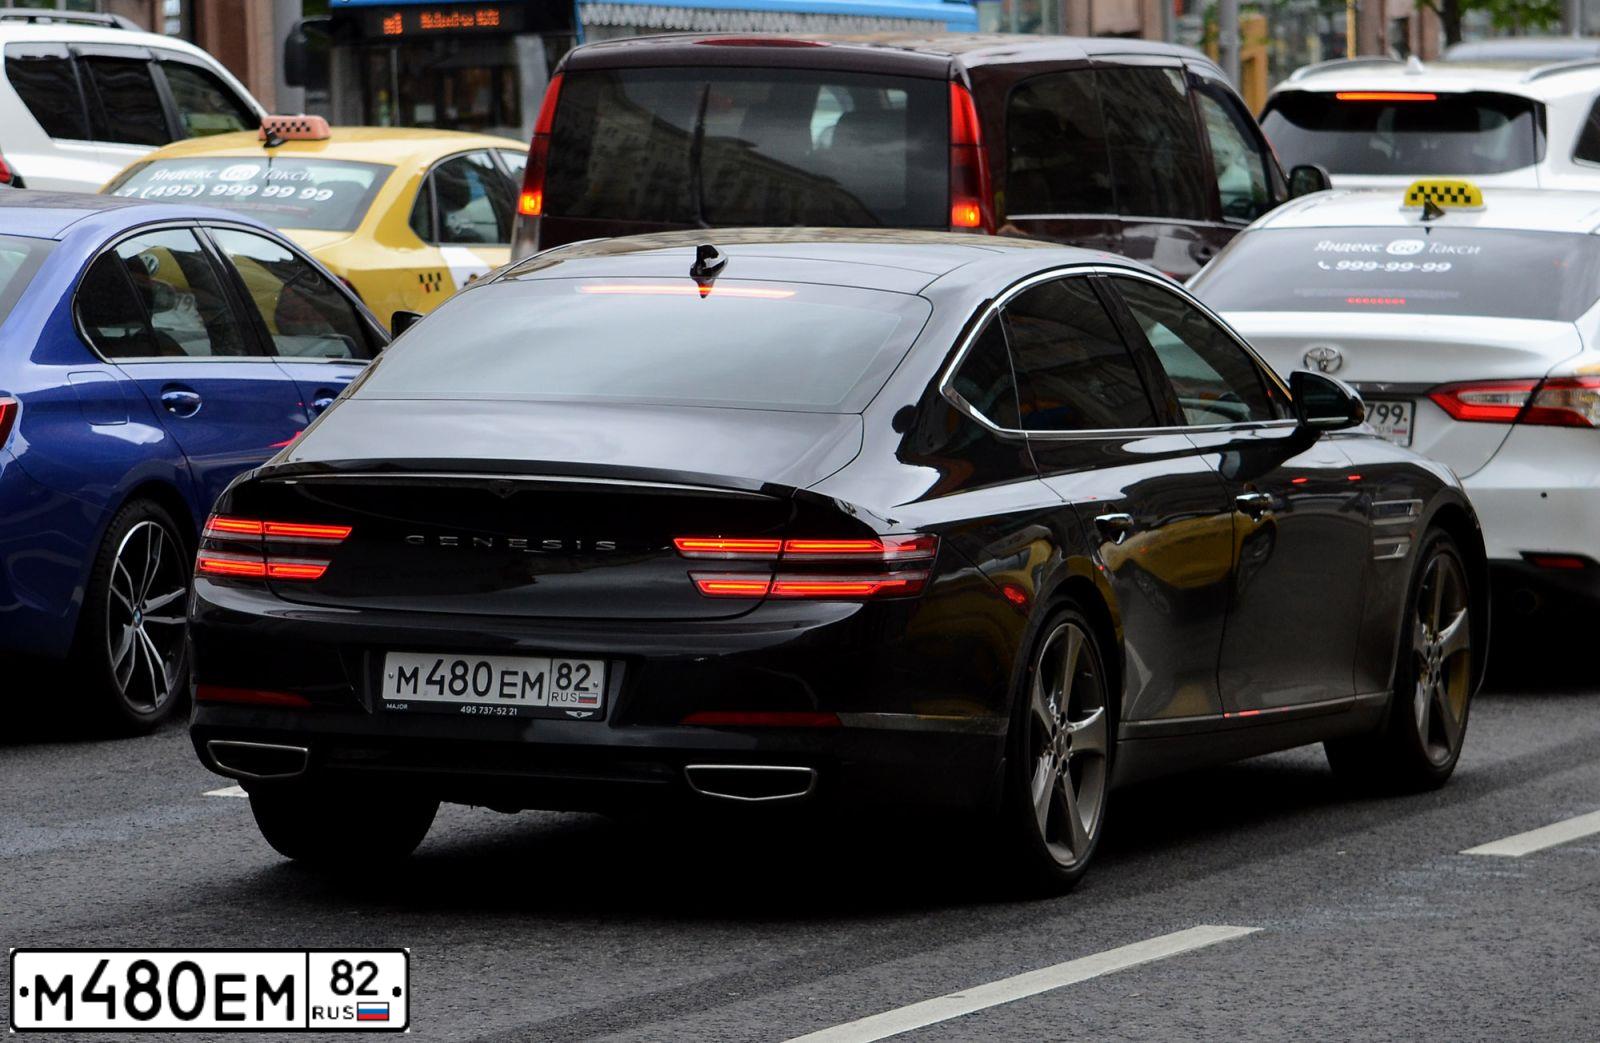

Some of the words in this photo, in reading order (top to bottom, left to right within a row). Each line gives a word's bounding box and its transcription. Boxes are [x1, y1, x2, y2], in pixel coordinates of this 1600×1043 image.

[149, 168, 219, 181] Яндекс
[141, 184, 205, 199] (495)
[209, 184, 258, 197] 999
[261, 185, 296, 199] 99
[298, 187, 333, 201] 99
[1313, 240, 1384, 253] Яндекс
[1428, 242, 1481, 255] Такси
[1336, 260, 1452, 273] 999-99-99
[1365, 403, 1404, 425] 799
[405, 535, 616, 551] GENESIS
[555, 662, 592, 692] 82
[551, 691, 578, 703] RUS
[460, 706, 477, 714] 495
[479, 706, 508, 716] 737-52
[508, 707, 518, 716] 21
